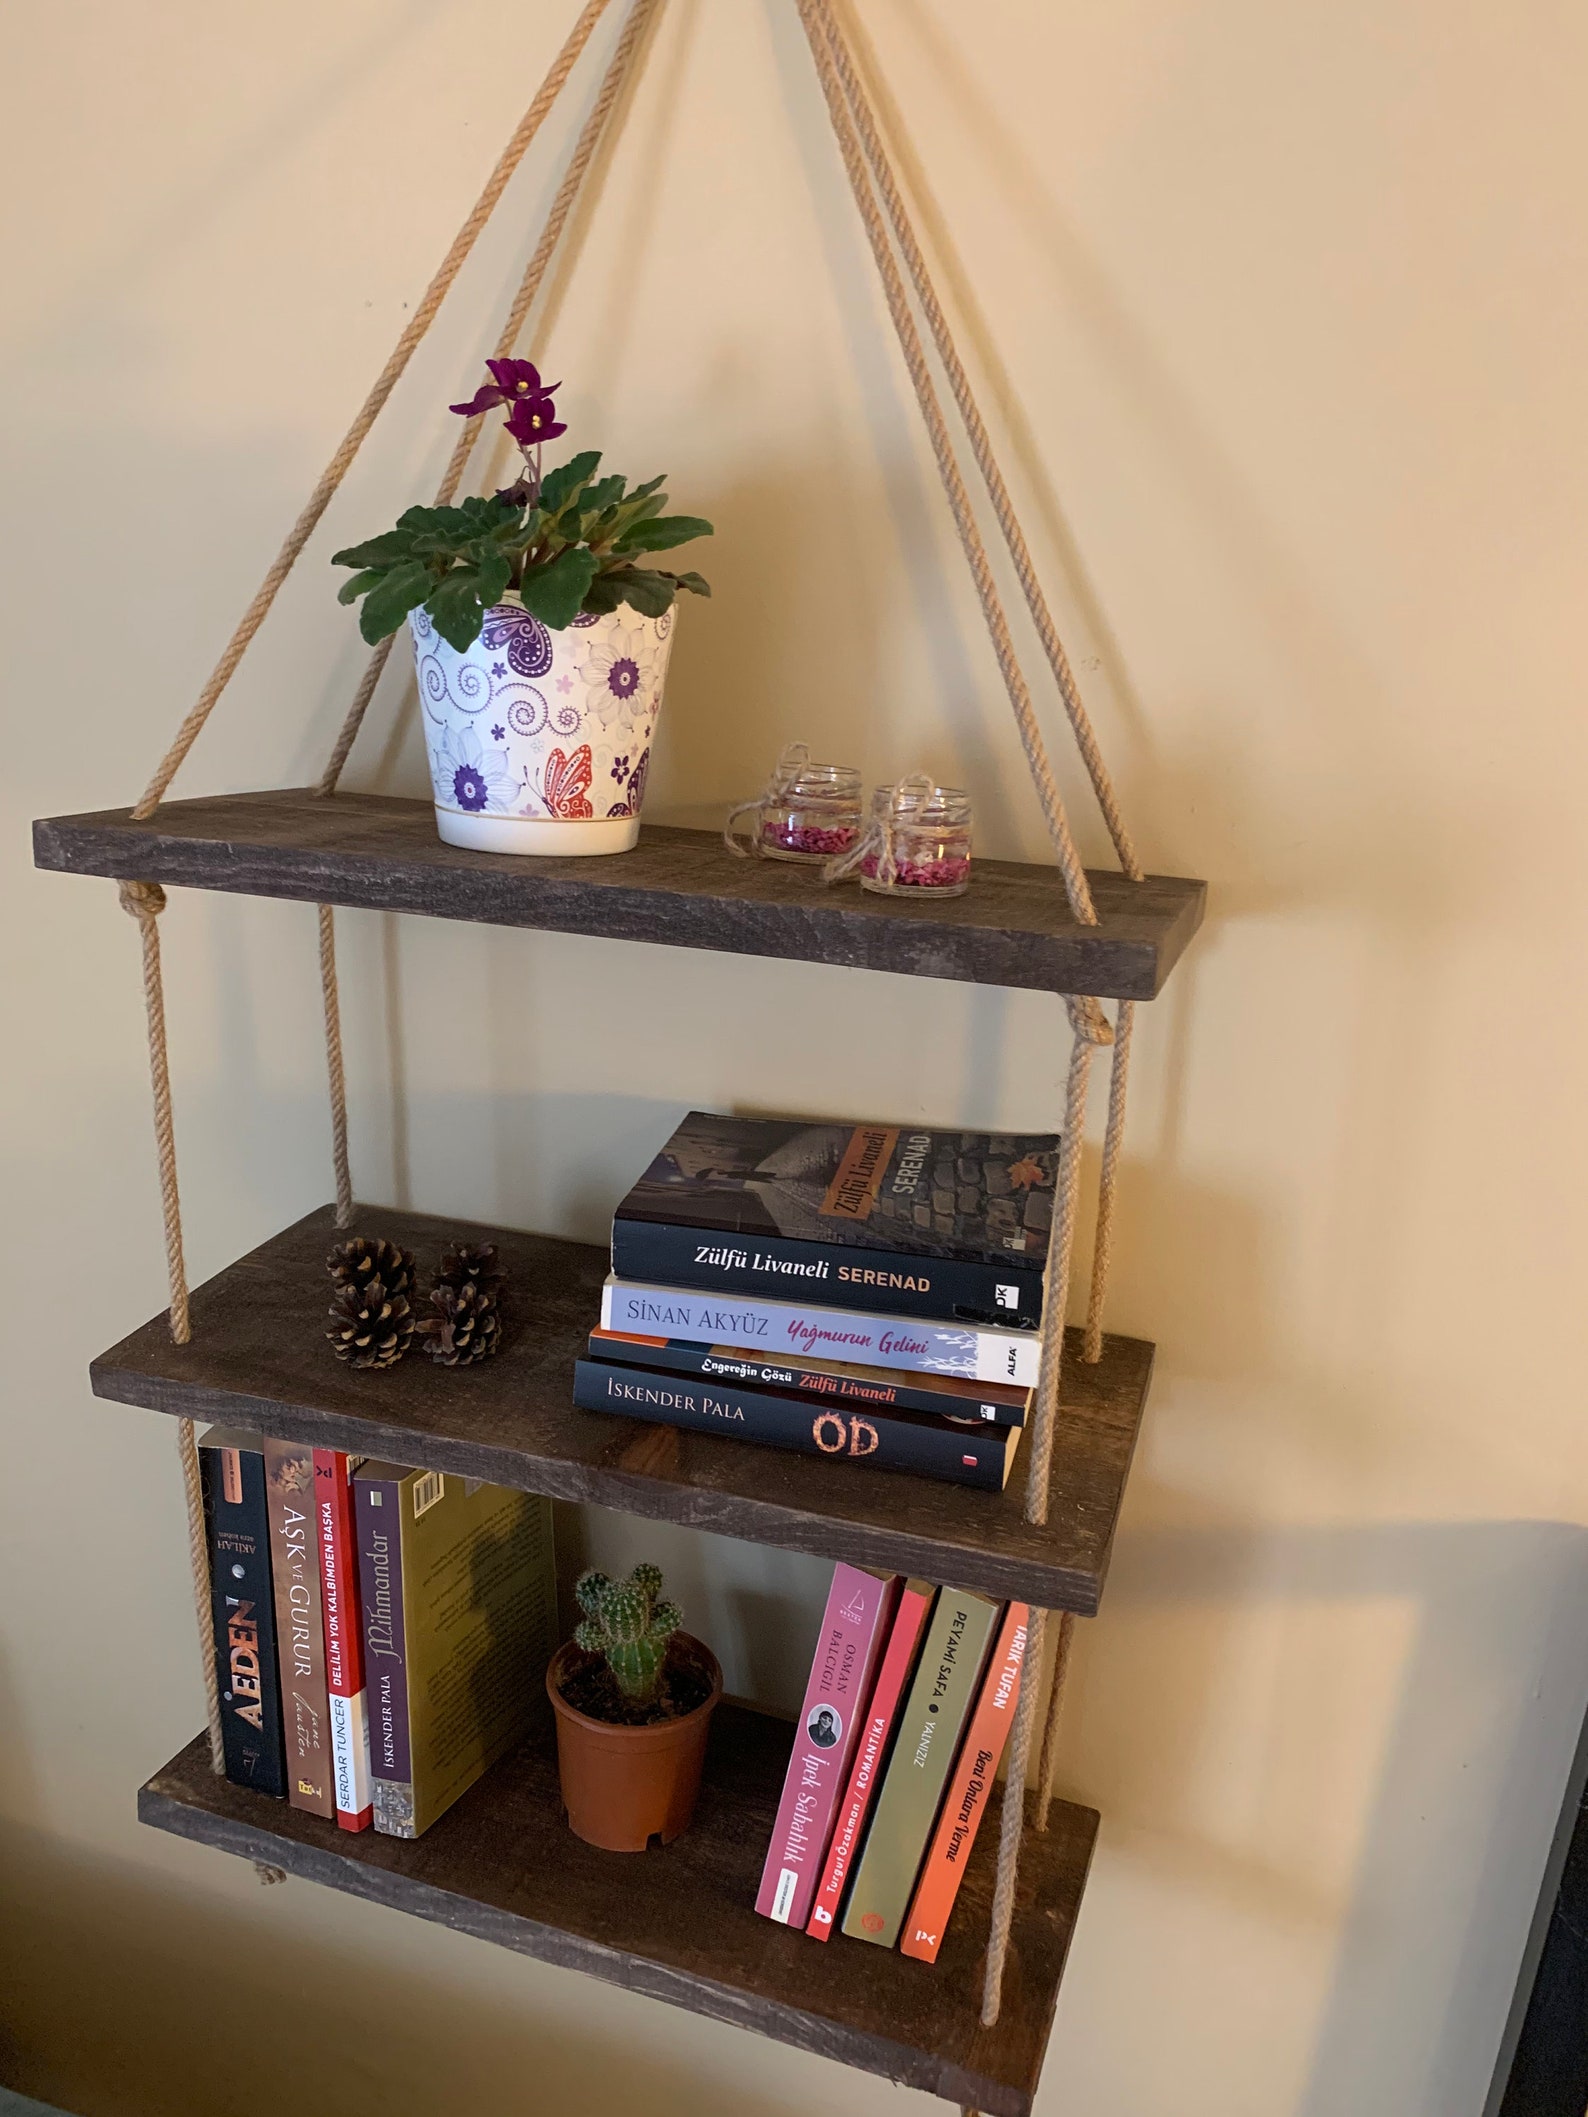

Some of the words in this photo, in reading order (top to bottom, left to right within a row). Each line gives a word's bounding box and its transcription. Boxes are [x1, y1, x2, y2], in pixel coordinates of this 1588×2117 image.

[848, 1131, 888, 1178] Livaneli
[892, 1135, 931, 1195] SERENAD
[833, 1178, 873, 1214] Zülfü
[694, 1246, 747, 1272] Zülfü
[751, 1253, 830, 1279] Livaneli
[837, 1266, 931, 1293] SERENAD
[627, 1299, 691, 1326] SİNAN
[697, 1310, 769, 1336] AKYÜZ
[787, 1319, 873, 1352] Yağmurun
[879, 1331, 930, 1354] Gelini
[701, 1358, 758, 1378] Engereğin
[761, 1368, 792, 1384] Gözü
[799, 1374, 838, 1393] Zülfü
[840, 1381, 897, 1402] Livaneli
[1007, 1347, 1017, 1376] ALFA
[607, 1377, 696, 1412] İSKENDER
[702, 1397, 746, 1421] PALA
[812, 1410, 880, 1457] OD
[279, 1505, 307, 1560] AŞK
[322, 1502, 333, 1542] BAŞKA
[291, 1564, 304, 1581] VE
[324, 1544, 338, 1613] KALBİMDEN
[365, 1529, 402, 1664] Mihmandar
[289, 1585, 312, 1677] GURUR
[328, 1611, 339, 1637] YOK
[943, 1611, 968, 1665] PEYAMİ
[328, 1640, 343, 1687] DELİLİM
[836, 1644, 857, 1694] OSMAN
[932, 1665, 952, 1697] SAFA
[380, 1675, 391, 1704] PALA
[992, 1666, 1018, 1710] TUFAN
[334, 1699, 346, 1751] TUNCER
[382, 1706, 394, 1768] İSKENDER
[913, 1721, 936, 1769] YALNIZIZ
[802, 1754, 830, 1788] İpek
[856, 1718, 886, 1790] ROMANTİKA
[972, 1750, 994, 1780] Beni
[337, 1756, 350, 1808] SERDAR
[958, 1779, 984, 1823] Onlara
[783, 1792, 818, 1863] Sabahlık
[835, 1804, 860, 1856] Özakman
[946, 1825, 970, 1863] Verme
[826, 1857, 845, 1893] Turgut
